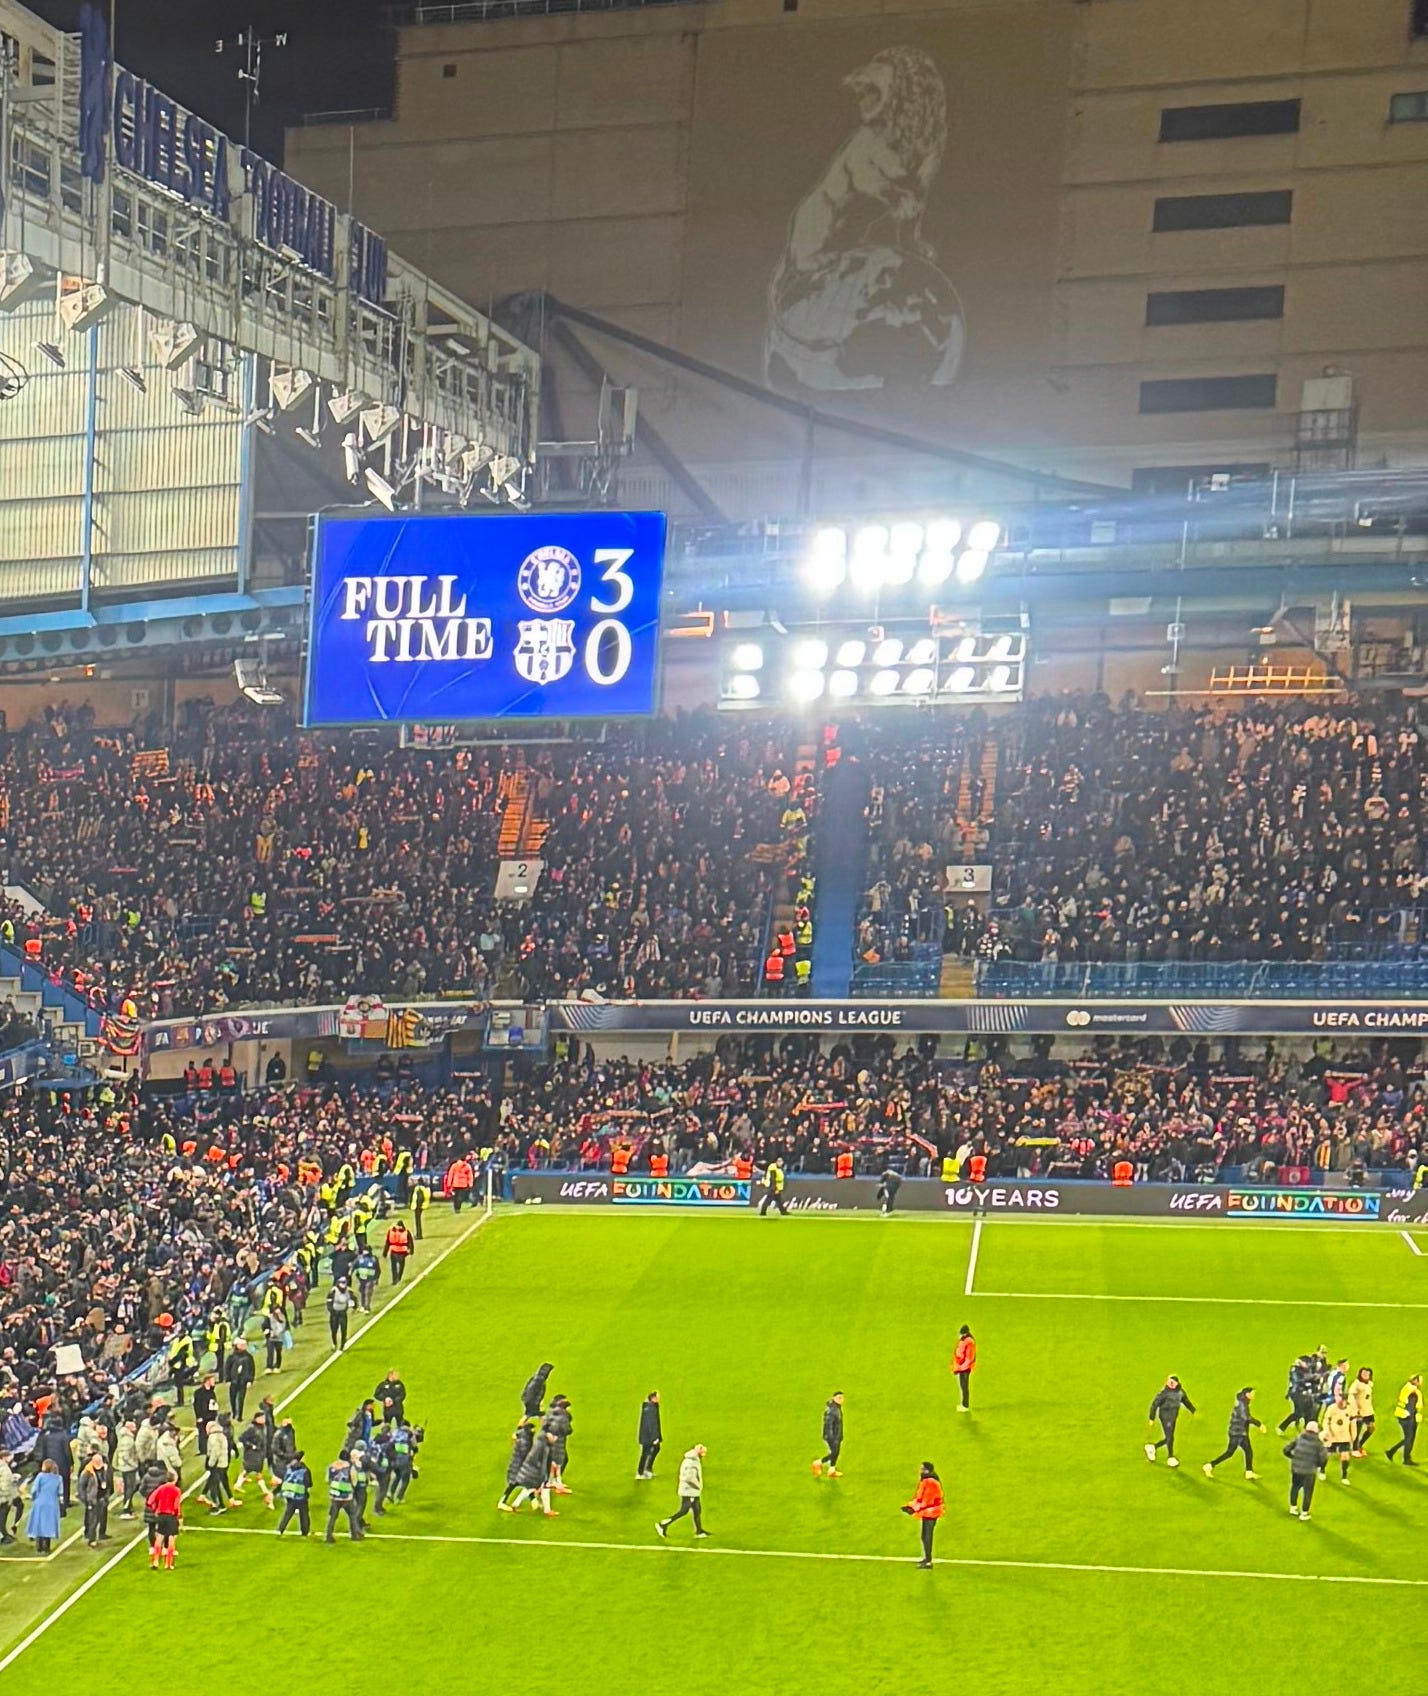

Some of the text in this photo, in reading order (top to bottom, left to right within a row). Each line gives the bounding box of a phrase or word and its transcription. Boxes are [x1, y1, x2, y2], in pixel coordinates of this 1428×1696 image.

[591, 548, 634, 613] 3
[340, 575, 467, 619] FULL
[366, 617, 494, 662] TIME
[584, 618, 632, 685] 0
[517, 863, 528, 878] 2
[963, 867, 975, 882] 3
[689, 1010, 902, 1025] UEFA CHAMPIONS LEAGUE
[1093, 1012, 1147, 1023] mastercard
[1313, 1012, 1360, 1027] UEFA
[559, 1180, 751, 1200] UEFA FOUNDATION
[973, 1189, 1060, 1208] YEARS
[1169, 1193, 1222, 1211] UEFA
[1227, 1193, 1381, 1213] FOUNDATION
